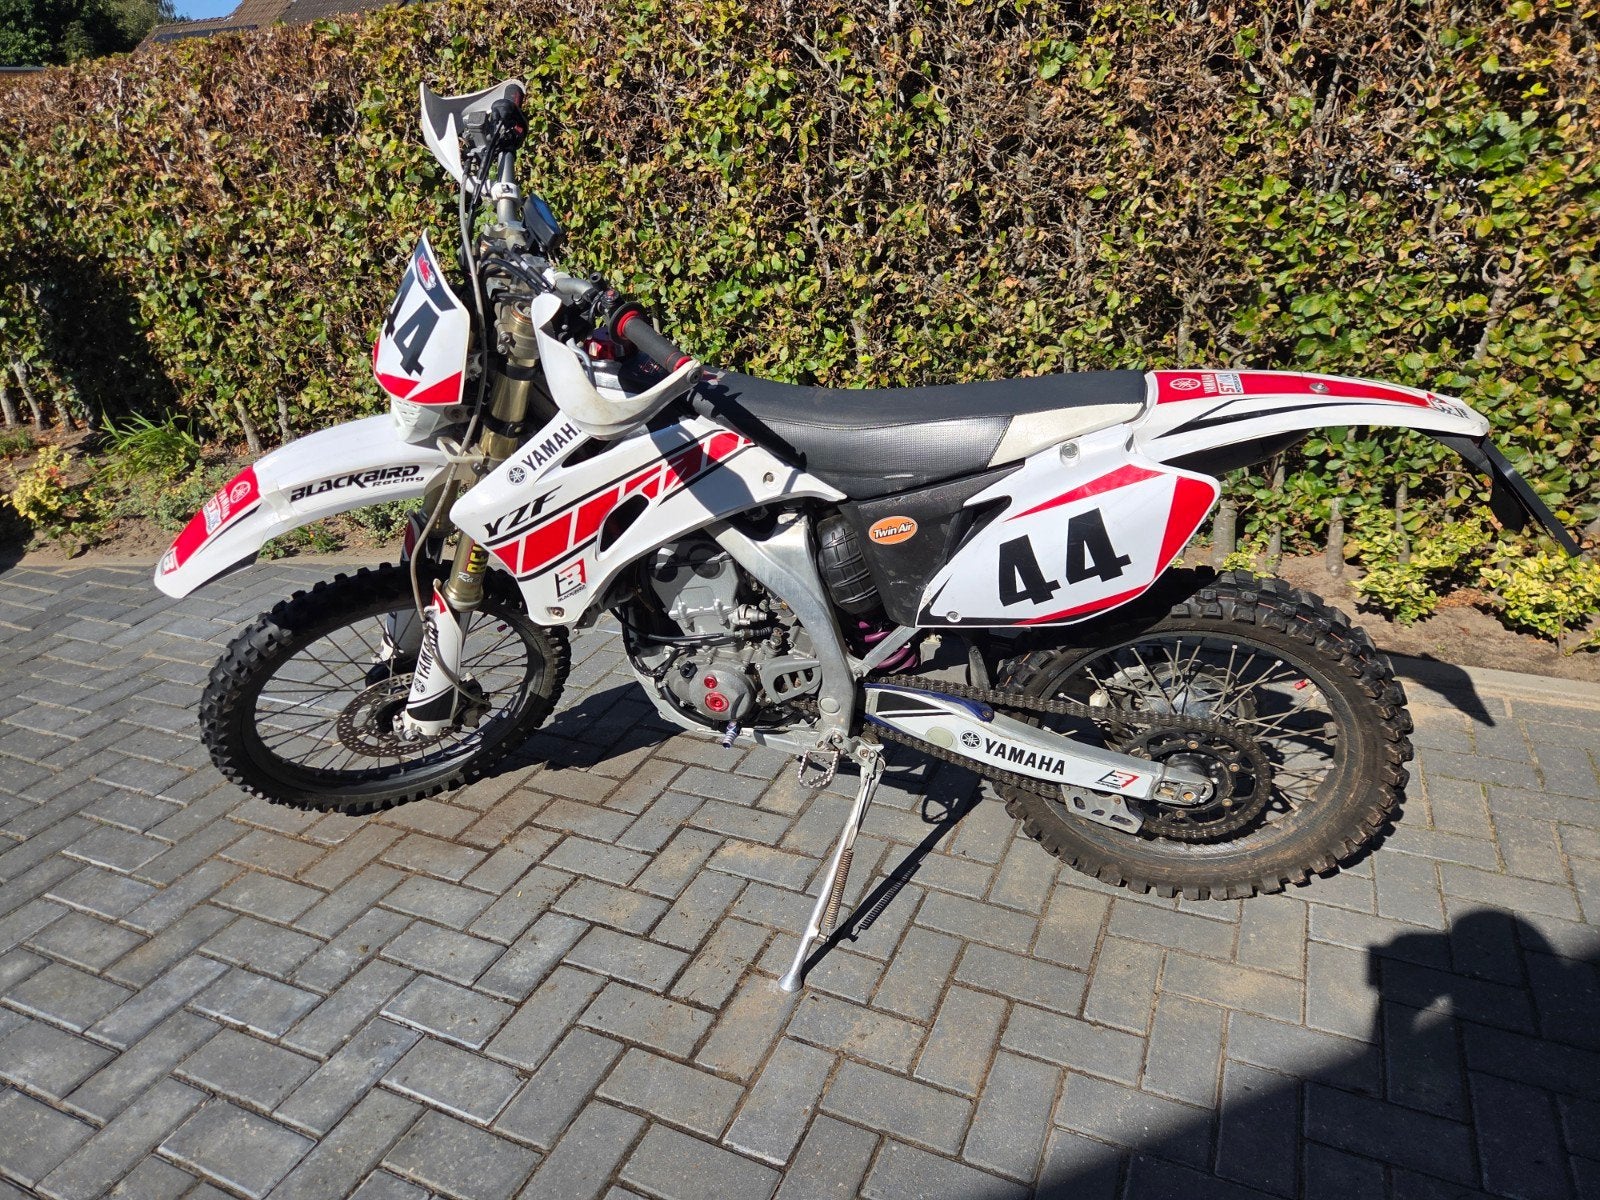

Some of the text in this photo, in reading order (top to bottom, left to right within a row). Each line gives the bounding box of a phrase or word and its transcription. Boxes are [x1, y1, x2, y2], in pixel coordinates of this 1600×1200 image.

[521, 422, 582, 471] YAMAH
[289, 464, 425, 503] BLACKBIRD Racing
[483, 484, 564, 538] YZF
[873, 521, 915, 540] Twin Air
[998, 507, 1132, 607] 44
[984, 737, 1066, 776] YAMAHA
